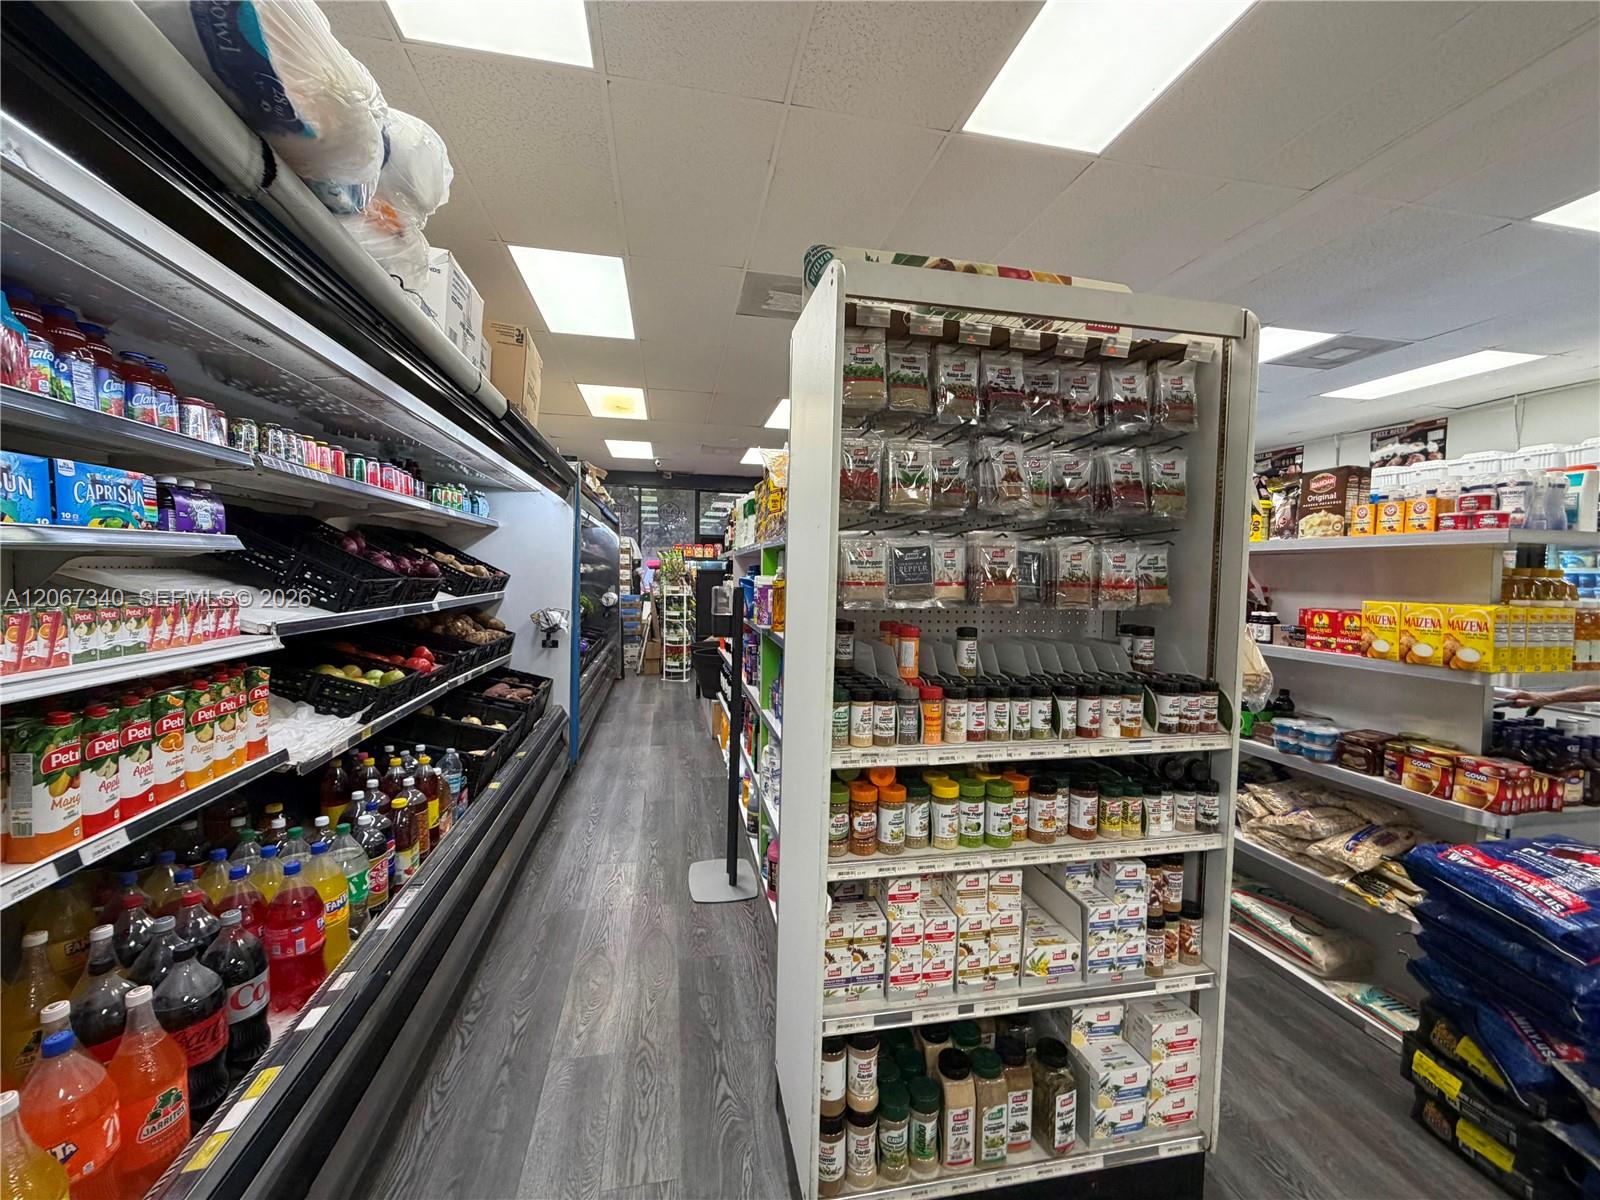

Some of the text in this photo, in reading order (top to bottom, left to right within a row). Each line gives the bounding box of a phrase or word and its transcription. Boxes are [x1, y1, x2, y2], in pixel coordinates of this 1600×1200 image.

[1307, 492, 1336, 502] Original
[101, 611, 117, 619] Petit
[126, 609, 141, 617] Petit
[1364, 614, 1397, 626] MAIZENA
[1403, 616, 1442, 629] MAIZENA
[1447, 619, 1489, 633] MAIZENA
[220, 702, 236, 713] Peti
[198, 709, 216, 721] Peti
[163, 717, 184, 730] Peti
[128, 726, 152, 741] Peti
[95, 740, 119, 754] Peti
[1412, 760, 1431, 769] GOYA
[1465, 771, 1487, 782] GOYA
[98, 777, 120, 793] Appl
[50, 792, 80, 811] Mang
[142, 1103, 187, 1138] JARRITOS
[953, 1113, 969, 1121] BADIA
[951, 1124, 969, 1132] Garlic
